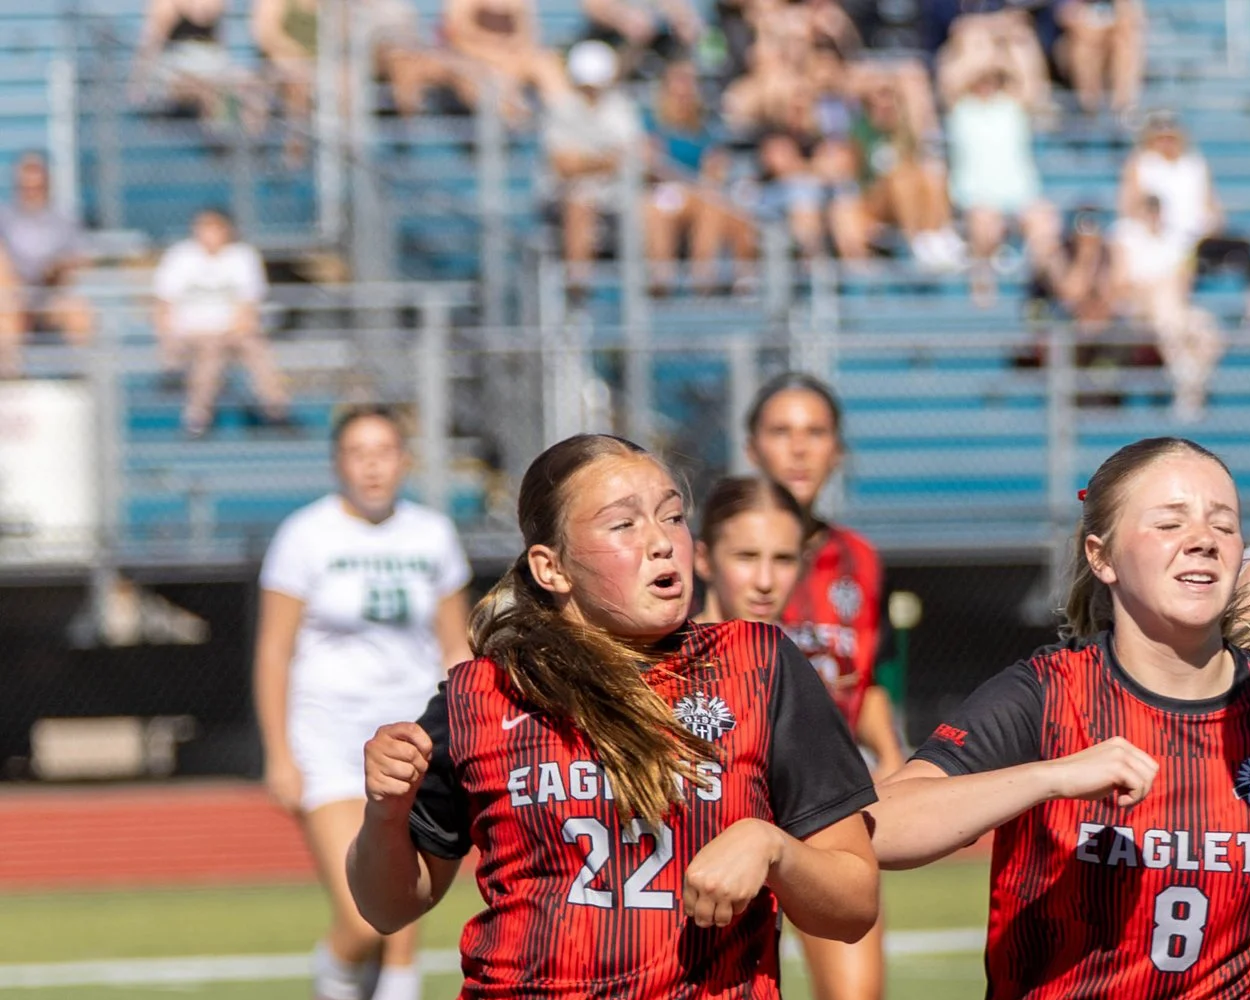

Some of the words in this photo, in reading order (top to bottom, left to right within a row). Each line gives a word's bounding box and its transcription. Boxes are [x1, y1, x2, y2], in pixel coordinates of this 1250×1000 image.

[506, 760, 723, 808] EAGS
[561, 816, 675, 909] 22
[1149, 884, 1209, 974] 8
